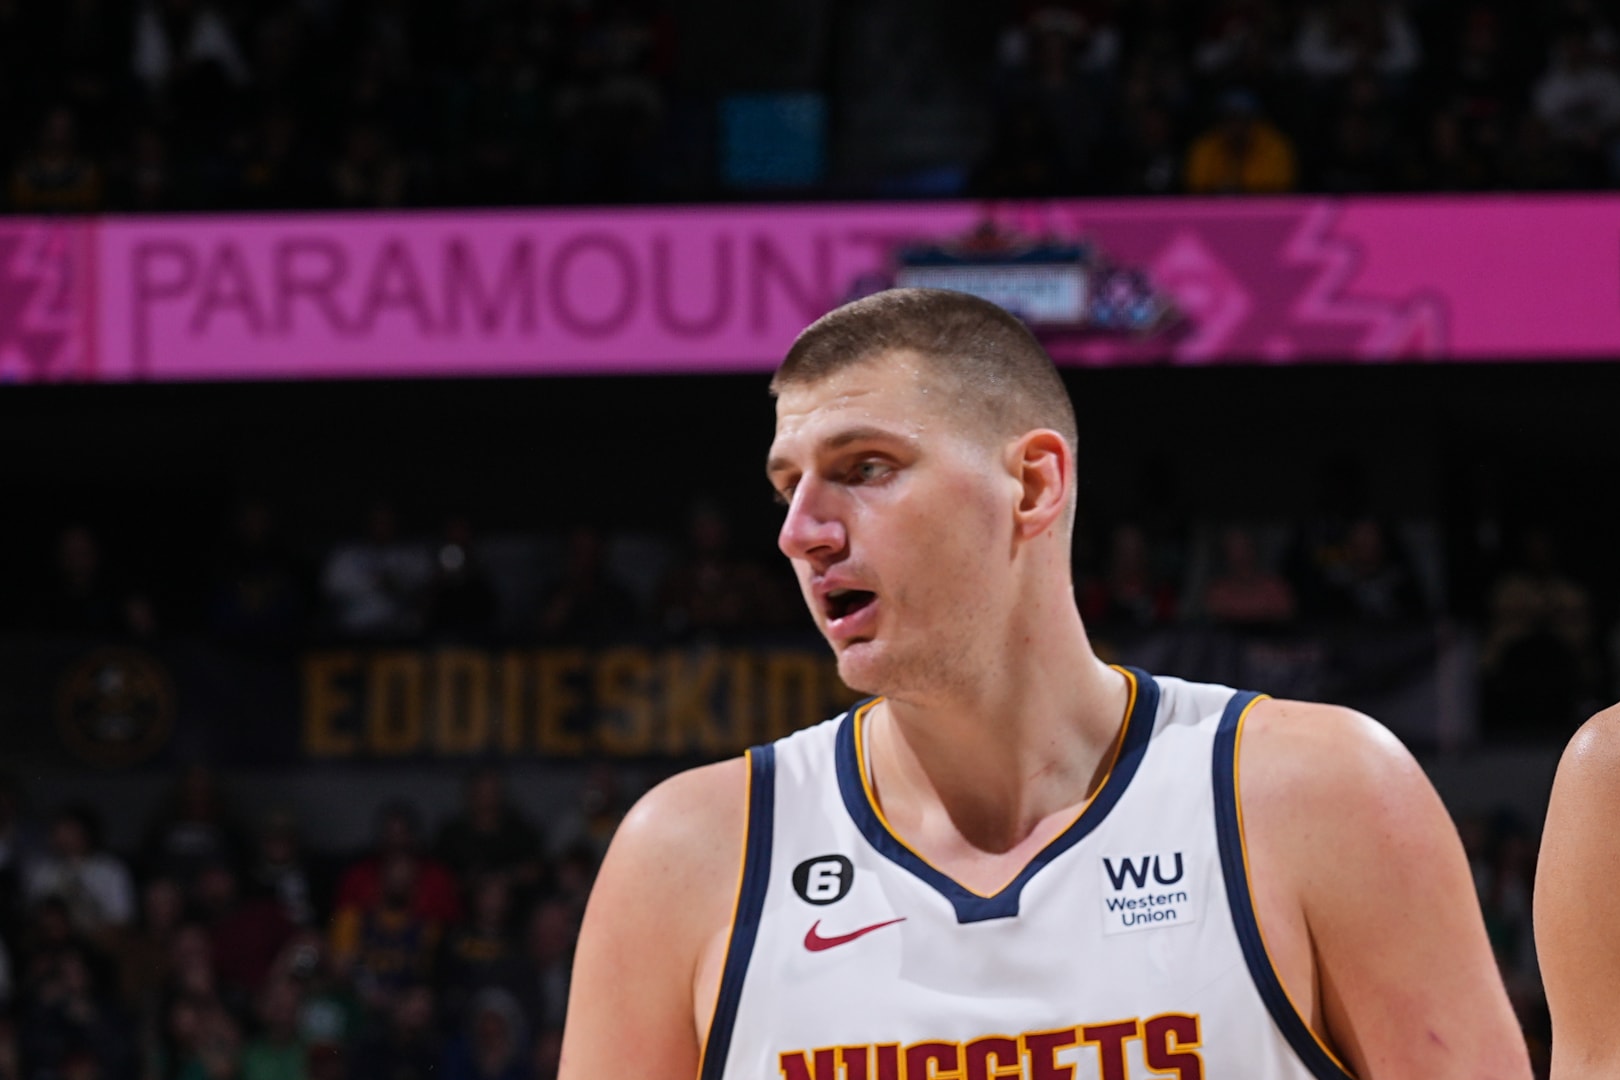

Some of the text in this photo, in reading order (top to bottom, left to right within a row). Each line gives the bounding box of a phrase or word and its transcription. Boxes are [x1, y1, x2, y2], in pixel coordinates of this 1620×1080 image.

[805, 860, 842, 900] 6
[1102, 852, 1184, 891] WU
[1106, 891, 1187, 912] Western
[1122, 908, 1176, 926] Union
